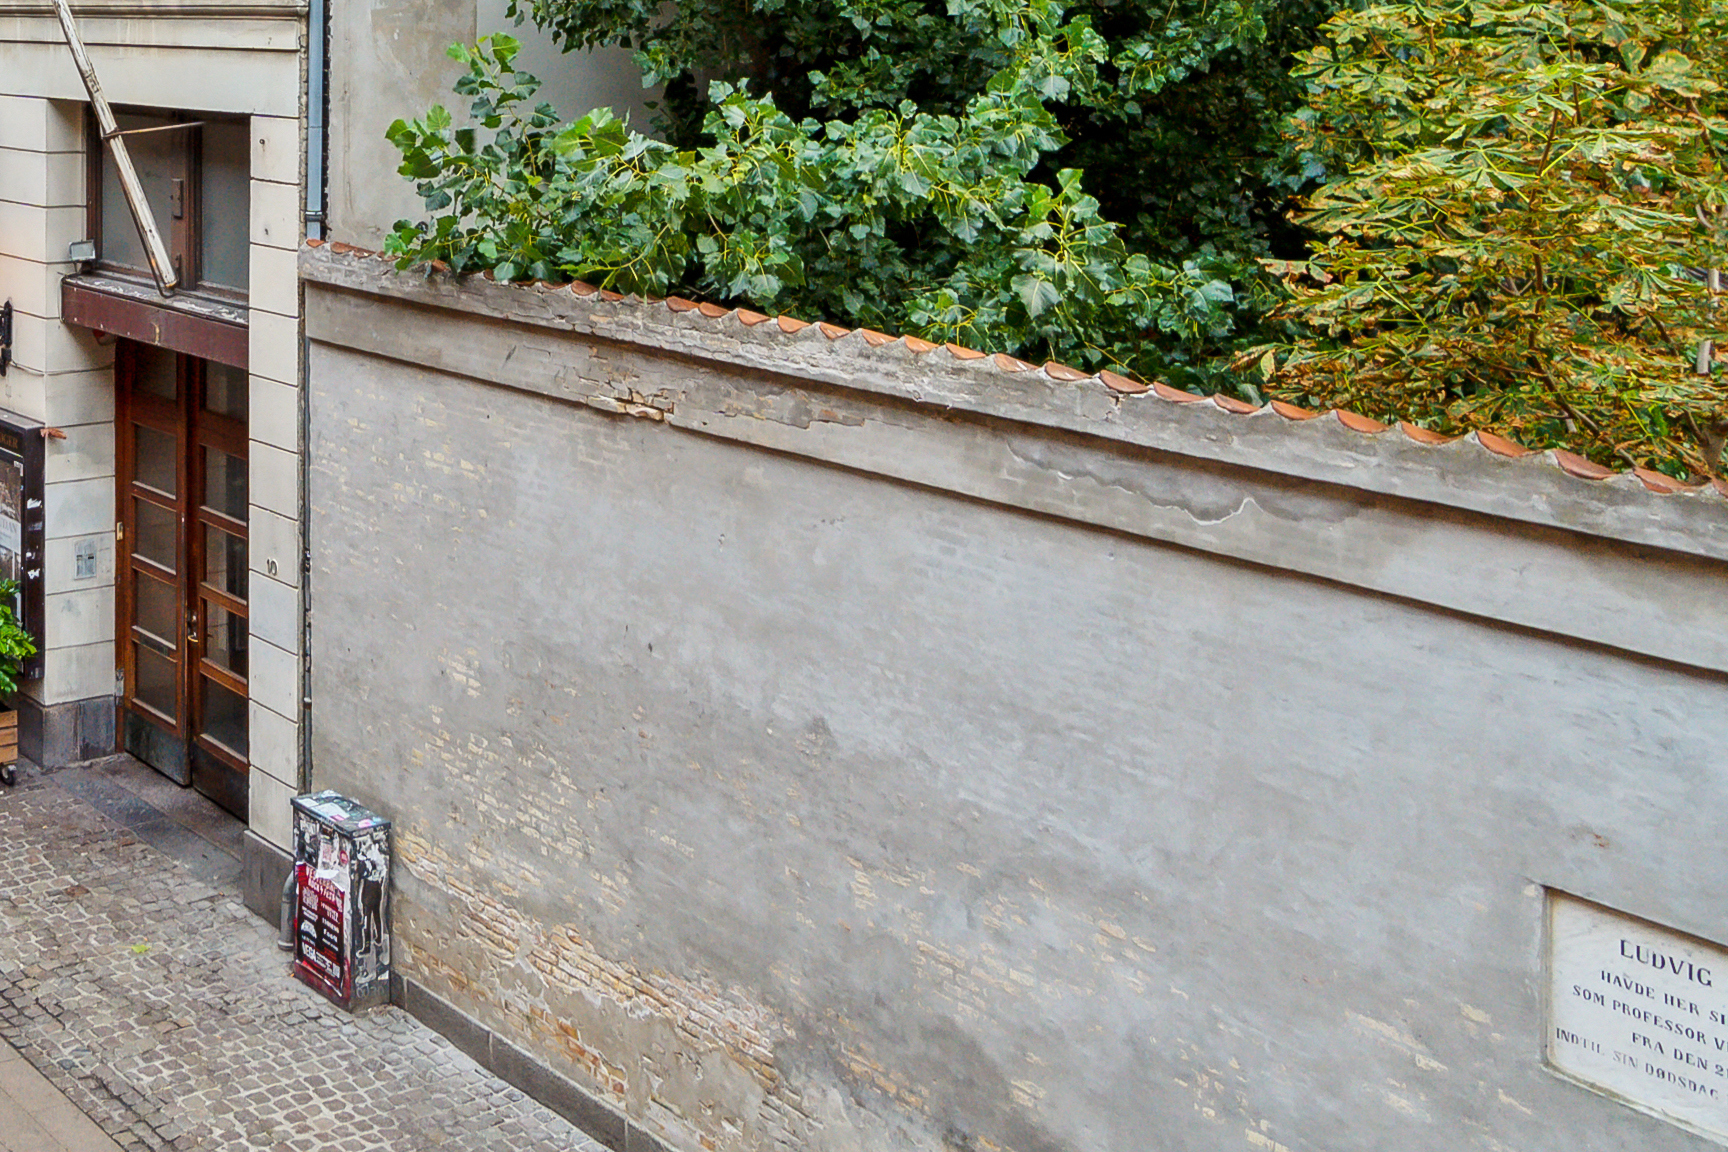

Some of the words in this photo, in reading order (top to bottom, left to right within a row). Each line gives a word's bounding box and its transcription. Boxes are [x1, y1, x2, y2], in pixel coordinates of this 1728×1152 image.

[1619, 938, 1713, 988] LUDVIG
[1572, 984, 1606, 1007] SOM
[1612, 999, 1707, 1045] PROFESSOR
[1663, 992, 1701, 1016] HER
[1612, 1050, 1639, 1069] SIN
[1631, 1031, 1665, 1055] FRA
[1673, 1047, 1708, 1071] DEN
